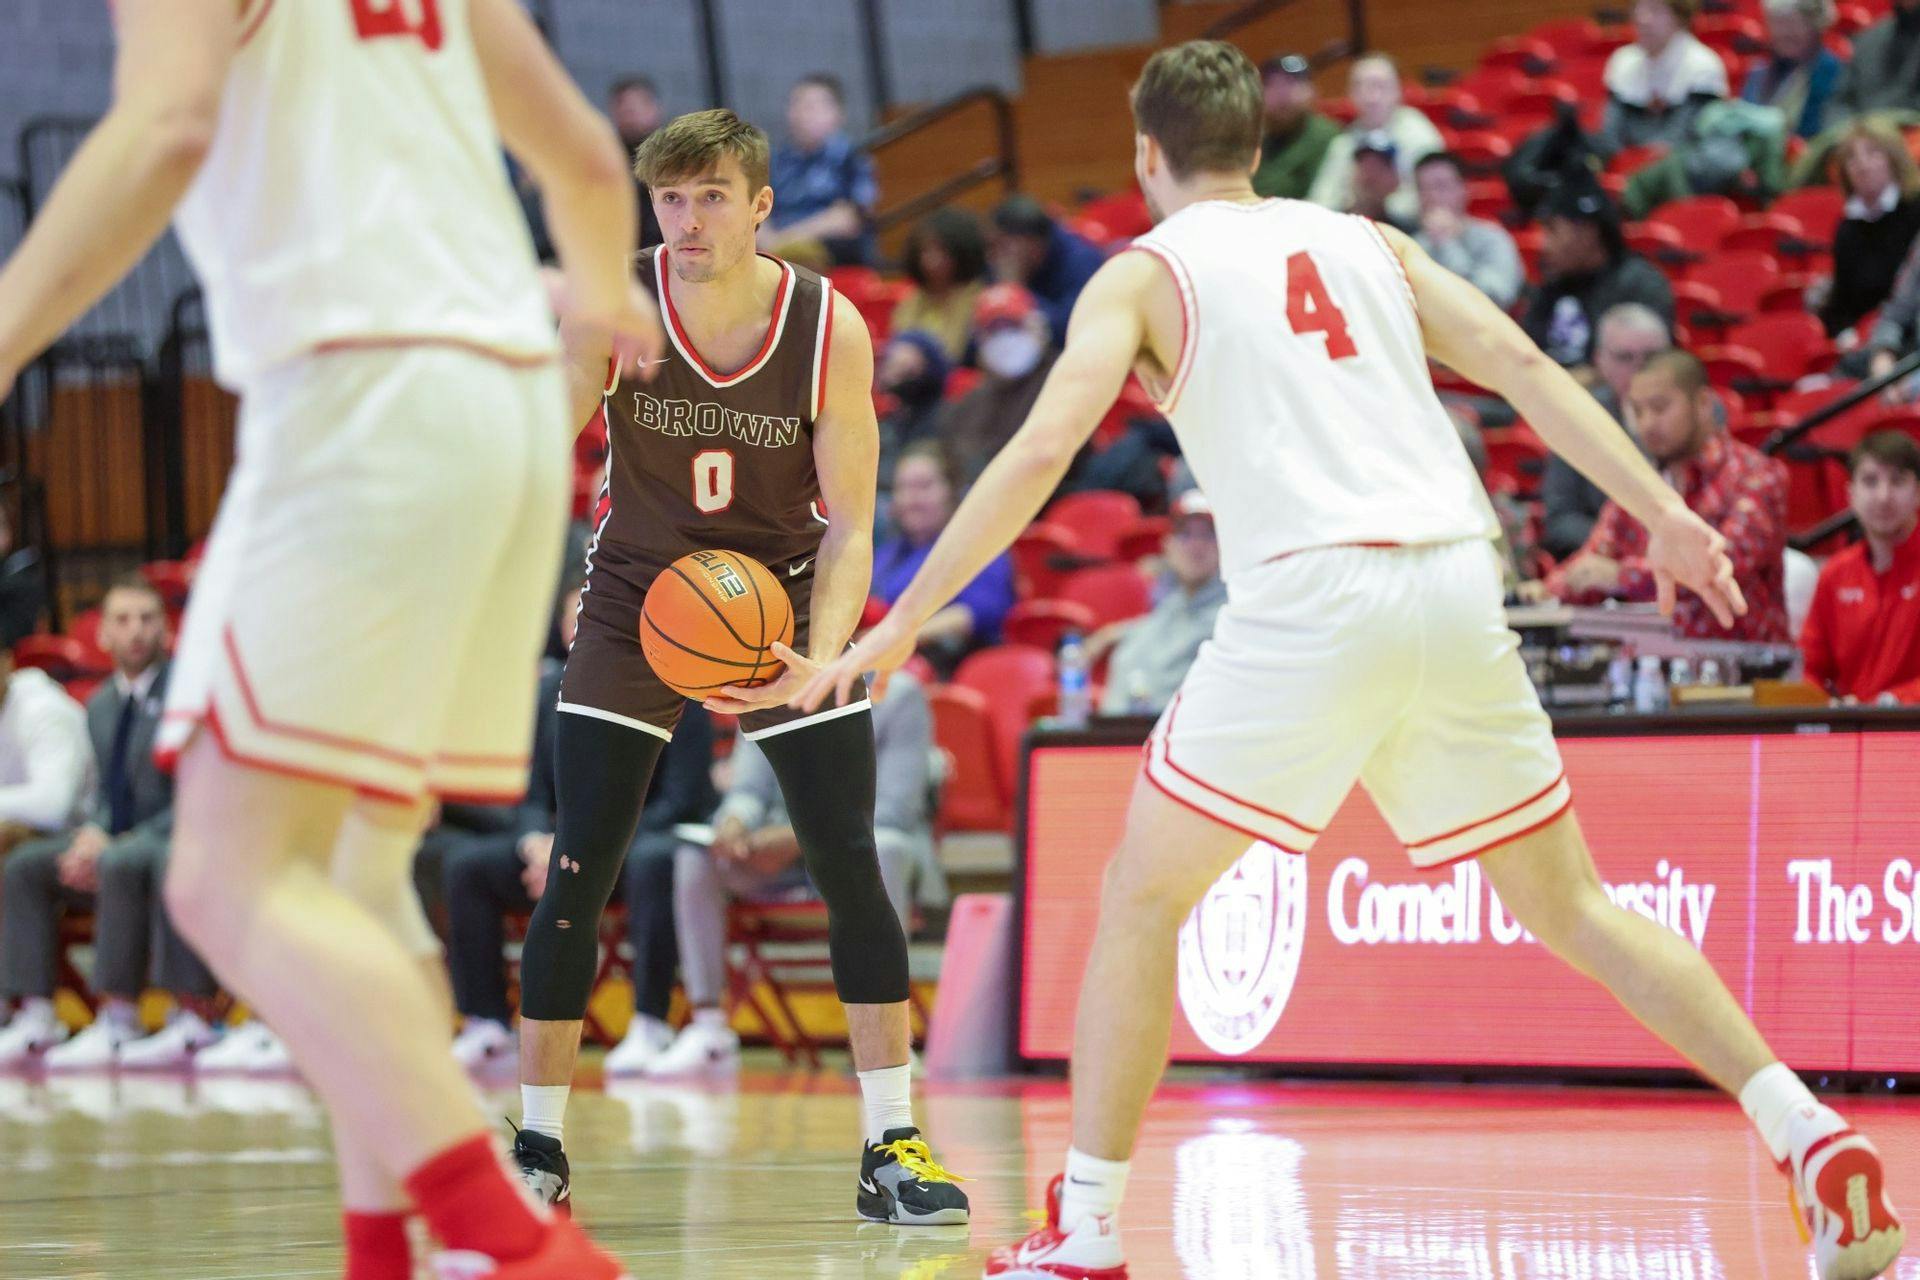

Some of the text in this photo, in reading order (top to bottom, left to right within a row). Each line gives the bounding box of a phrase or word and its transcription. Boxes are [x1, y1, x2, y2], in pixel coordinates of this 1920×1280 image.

[1286, 250, 1359, 360] 4
[633, 391, 800, 449] BROWN
[691, 448, 735, 515] 0
[689, 551, 749, 600] ELITE
[1328, 857, 1716, 951] Cornell Ursity
[1787, 857, 1920, 945] The S
